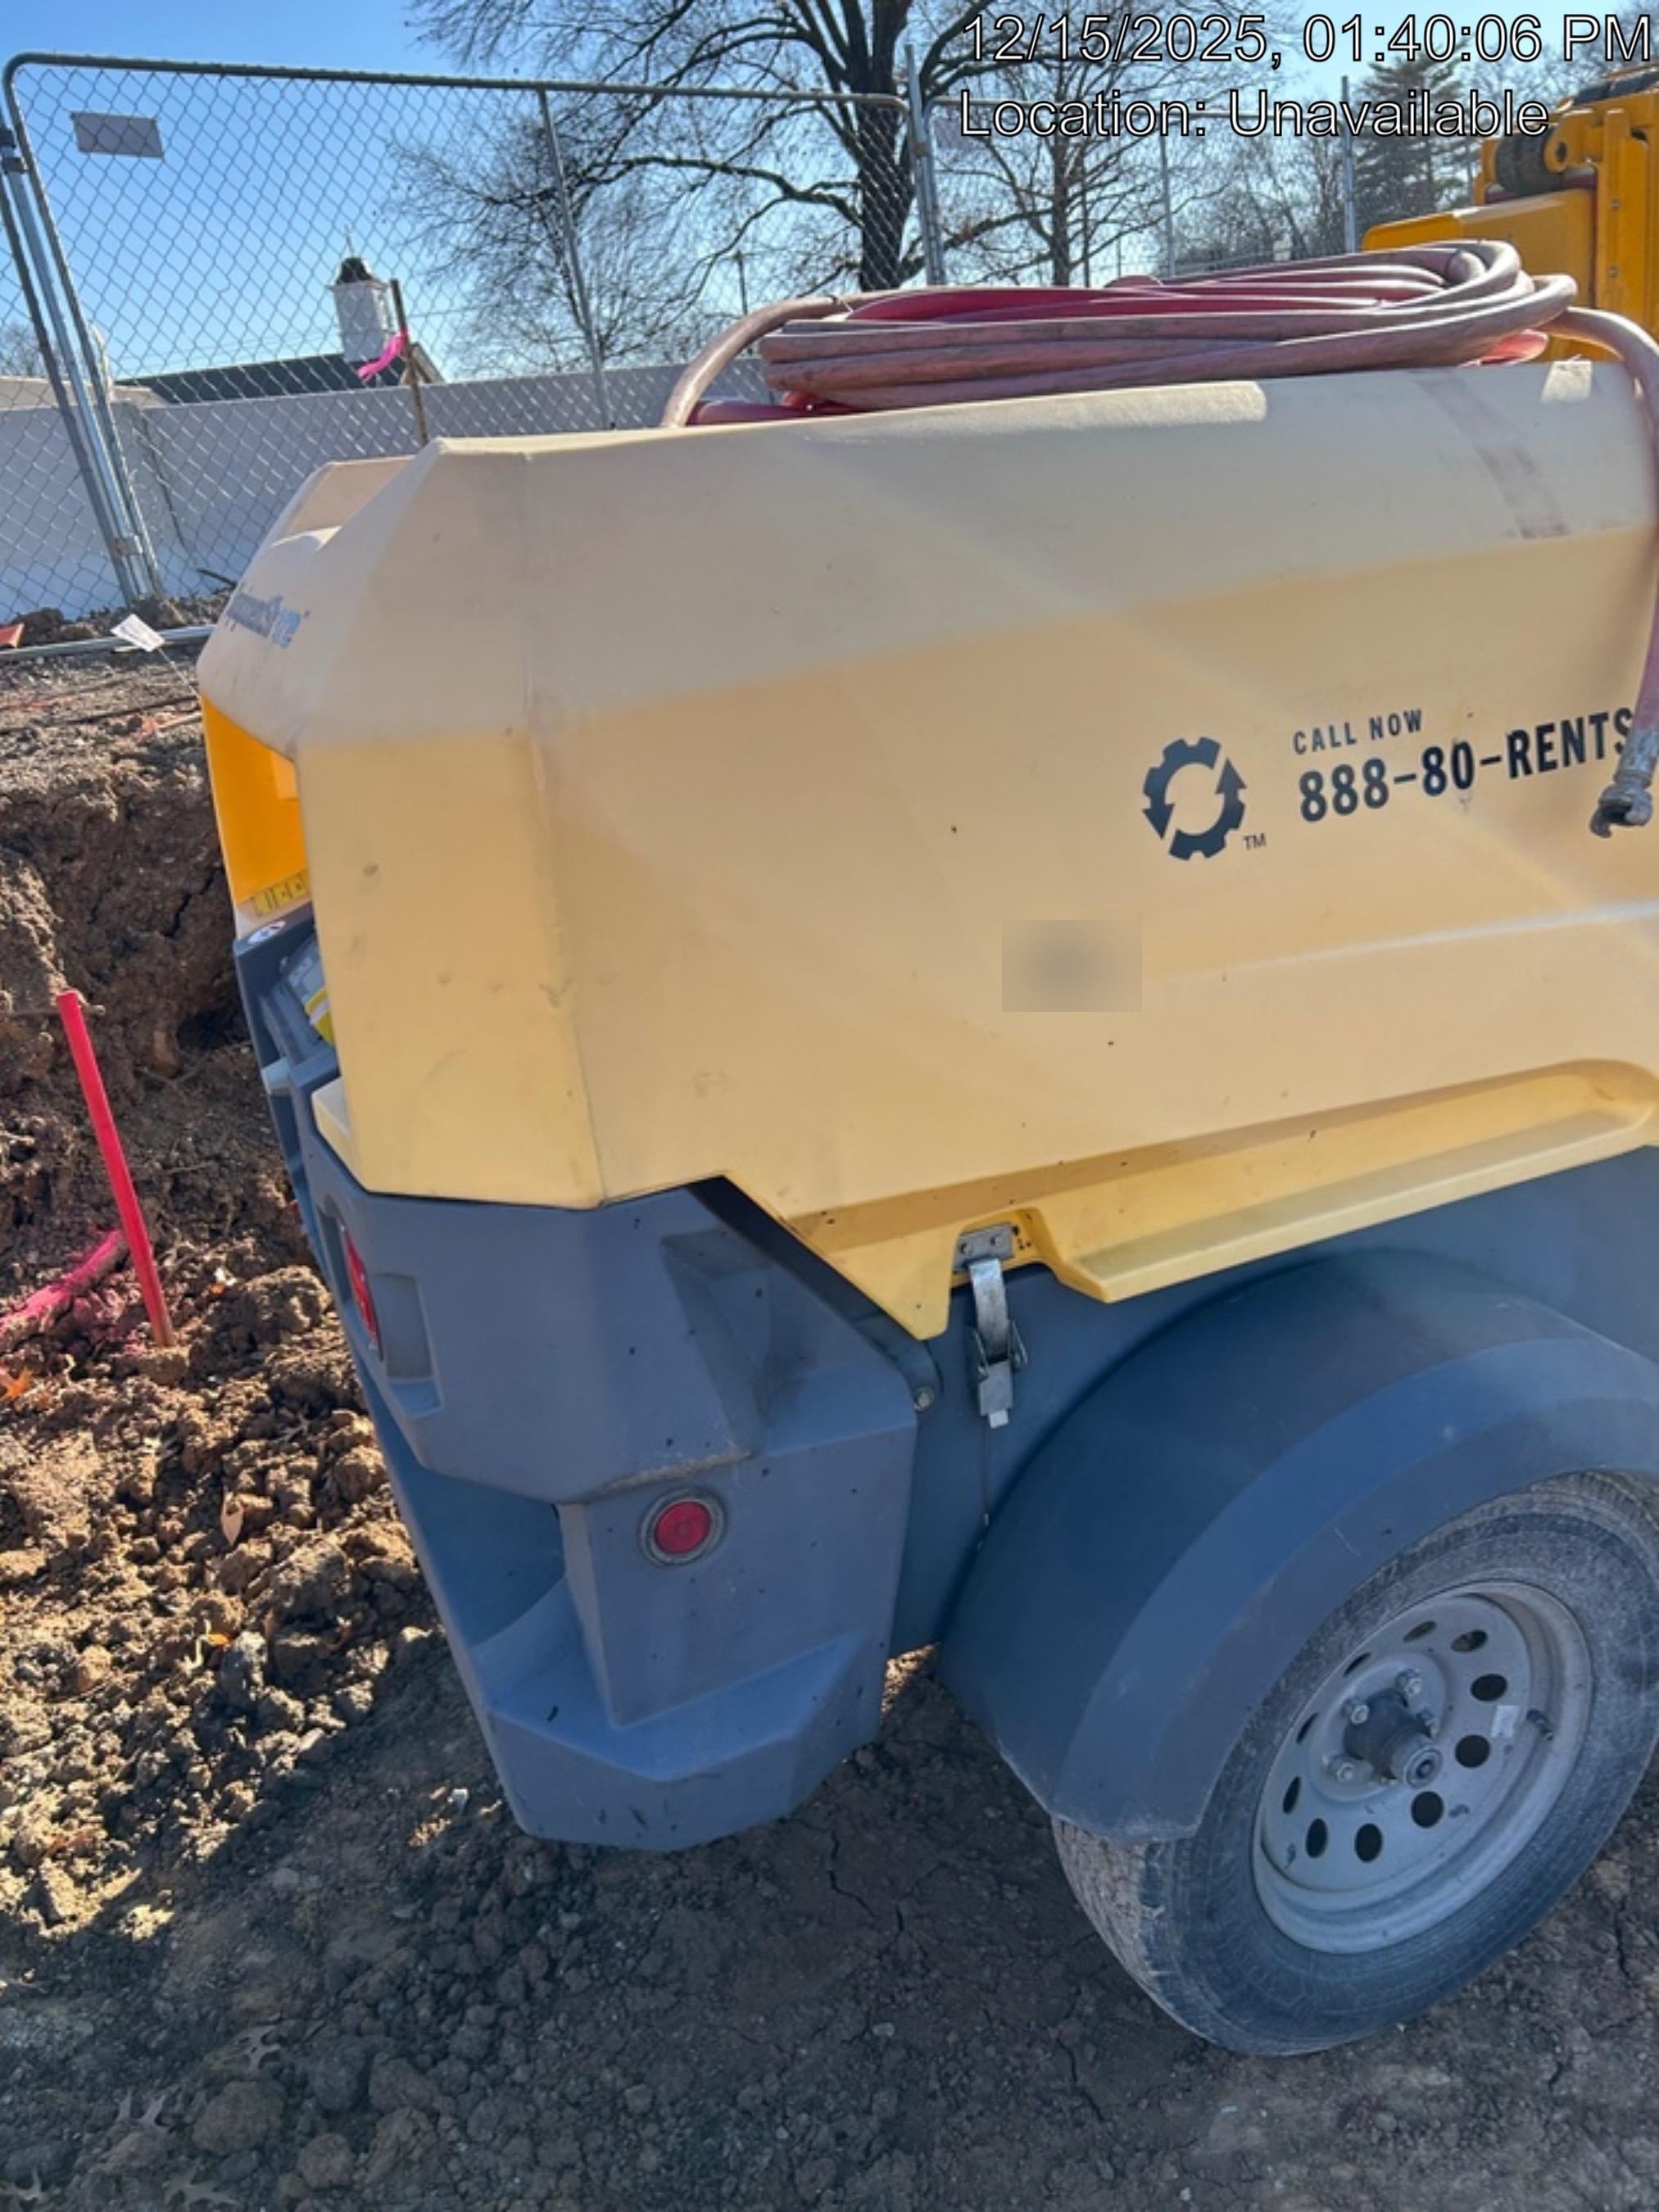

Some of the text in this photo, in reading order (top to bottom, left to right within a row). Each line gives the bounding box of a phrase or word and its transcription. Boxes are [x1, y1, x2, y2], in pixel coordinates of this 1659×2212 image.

[1293, 709, 1423, 755] CALL NOW
[1299, 707, 1633, 823] 888-80-RENTS
[1244, 833, 1267, 850] TM
